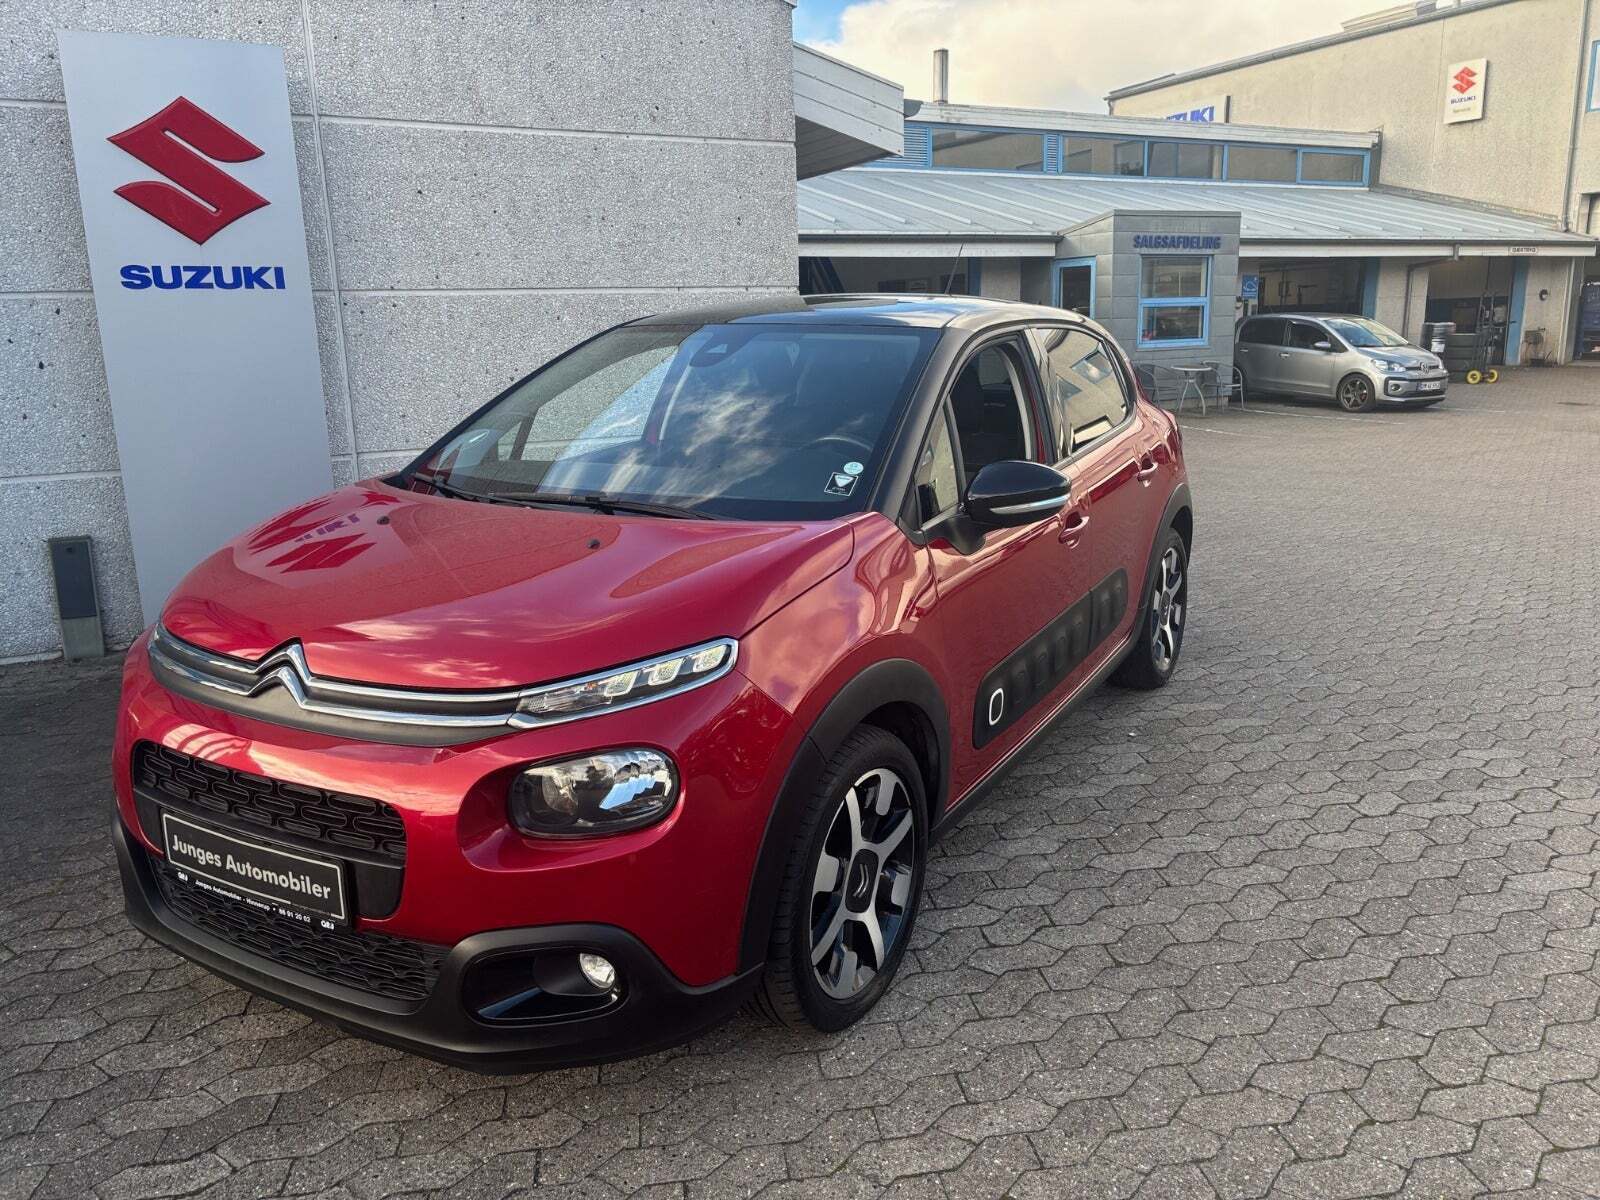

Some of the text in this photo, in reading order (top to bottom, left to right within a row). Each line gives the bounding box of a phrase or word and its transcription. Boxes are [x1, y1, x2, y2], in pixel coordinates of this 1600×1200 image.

[120, 265, 286, 290] SUZUKI
[173, 834, 331, 899] Junges Automobiler
